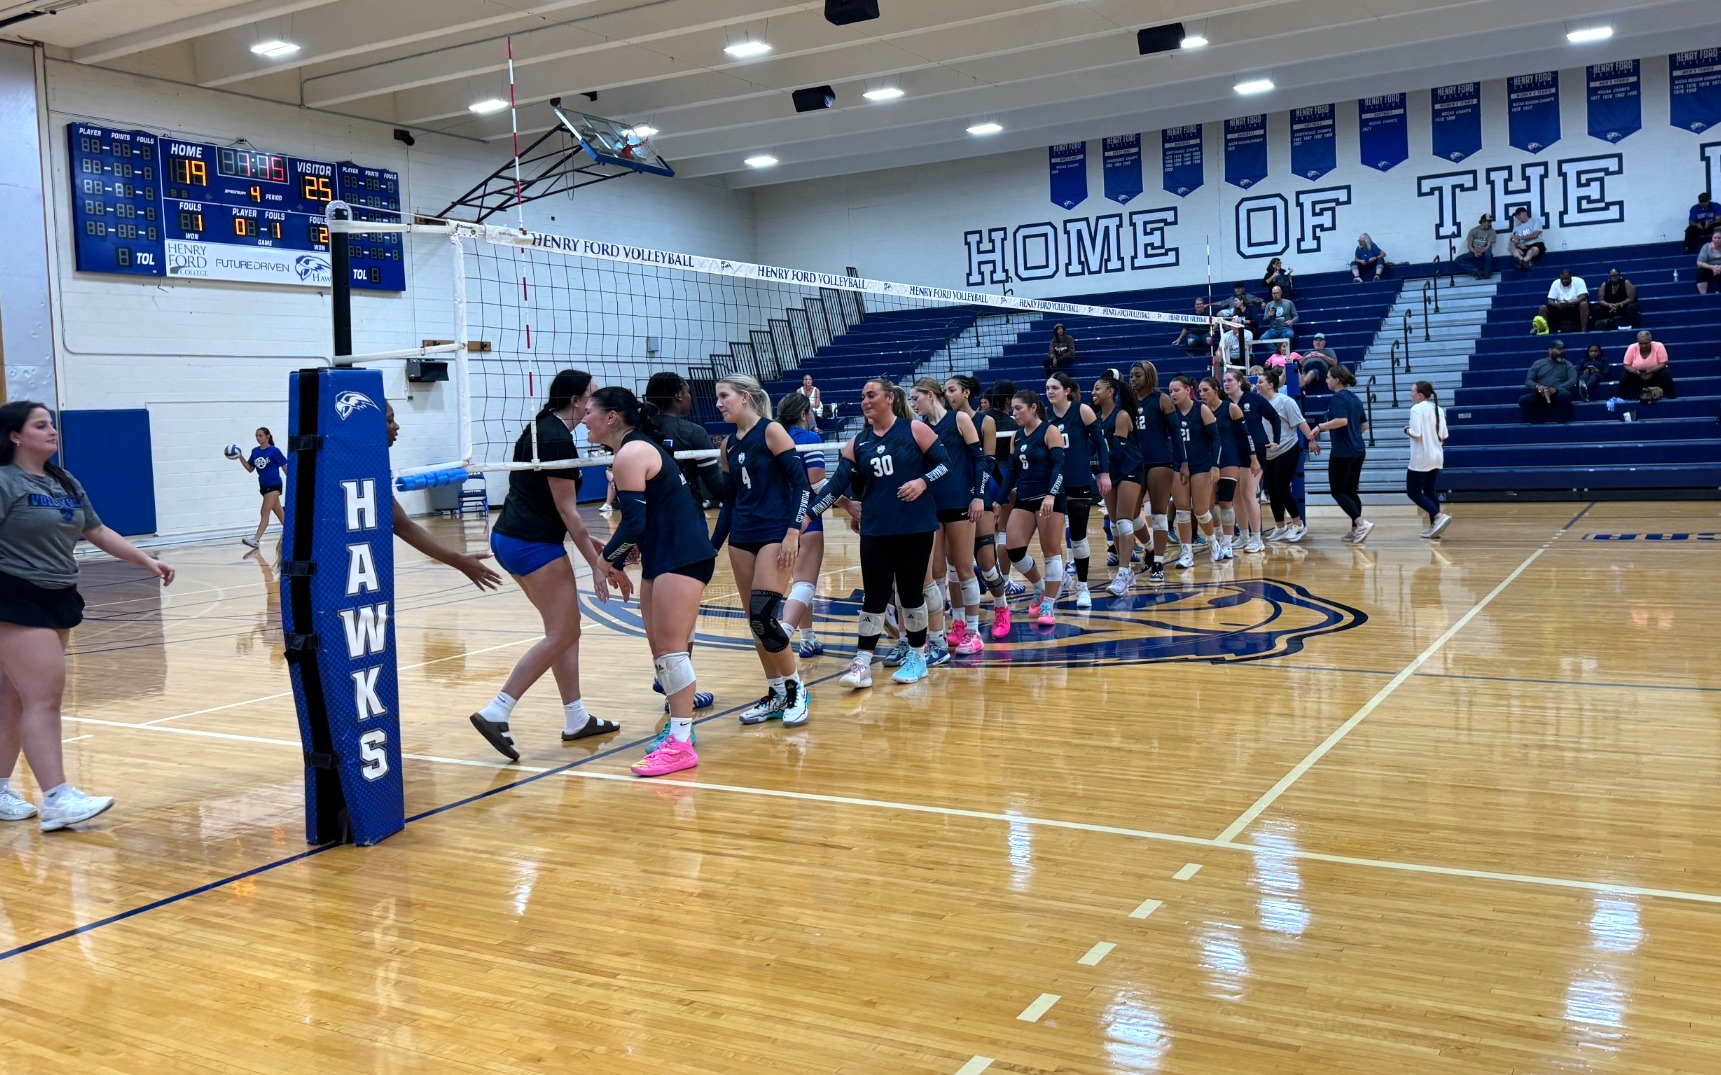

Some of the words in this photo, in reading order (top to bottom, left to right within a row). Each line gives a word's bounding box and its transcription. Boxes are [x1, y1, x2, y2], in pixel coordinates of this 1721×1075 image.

[79, 128, 102, 136] PLAYER
[171, 143, 202, 158] HOME
[186, 160, 206, 186] 19
[297, 162, 332, 176] VISITOR
[250, 186, 260, 202] 4
[305, 176, 332, 201] 25
[180, 202, 202, 211] FOULS
[232, 208, 257, 218] PLAYER
[265, 212, 285, 220] FOULS
[198, 214, 203, 231] 1
[309, 216, 328, 224] FOULS
[964, 206, 1180, 287] HOME
[1235, 184, 1352, 259] OF
[1417, 152, 1624, 240] THE
[276, 222, 281, 238] 1
[319, 227, 328, 243] 2
[168, 243, 207, 255] HENRY
[531, 233, 579, 252] HENRY
[583, 240, 620, 258] FORD
[622, 246, 695, 268] VOLLEYBALL
[136, 252, 155, 265] TOL
[169, 254, 207, 269] FORD
[216, 259, 289, 272] FUTUREDRIVEN
[180, 268, 208, 276] COLLEGE
[312, 274, 331, 282] HAW
[353, 269, 368, 279] TOL
[757, 265, 789, 280] HENRY
[791, 270, 817, 284] FORD
[818, 273, 867, 290] VOLLEYBALL
[910, 286, 932, 297] HENRY
[933, 288, 951, 298] FORD
[953, 290, 988, 303] VOLLEYBALL
[870, 454, 894, 477] 30
[1019, 455, 1029, 469] 6
[742, 466, 751, 489] 4
[339, 478, 388, 782] HAWKS
